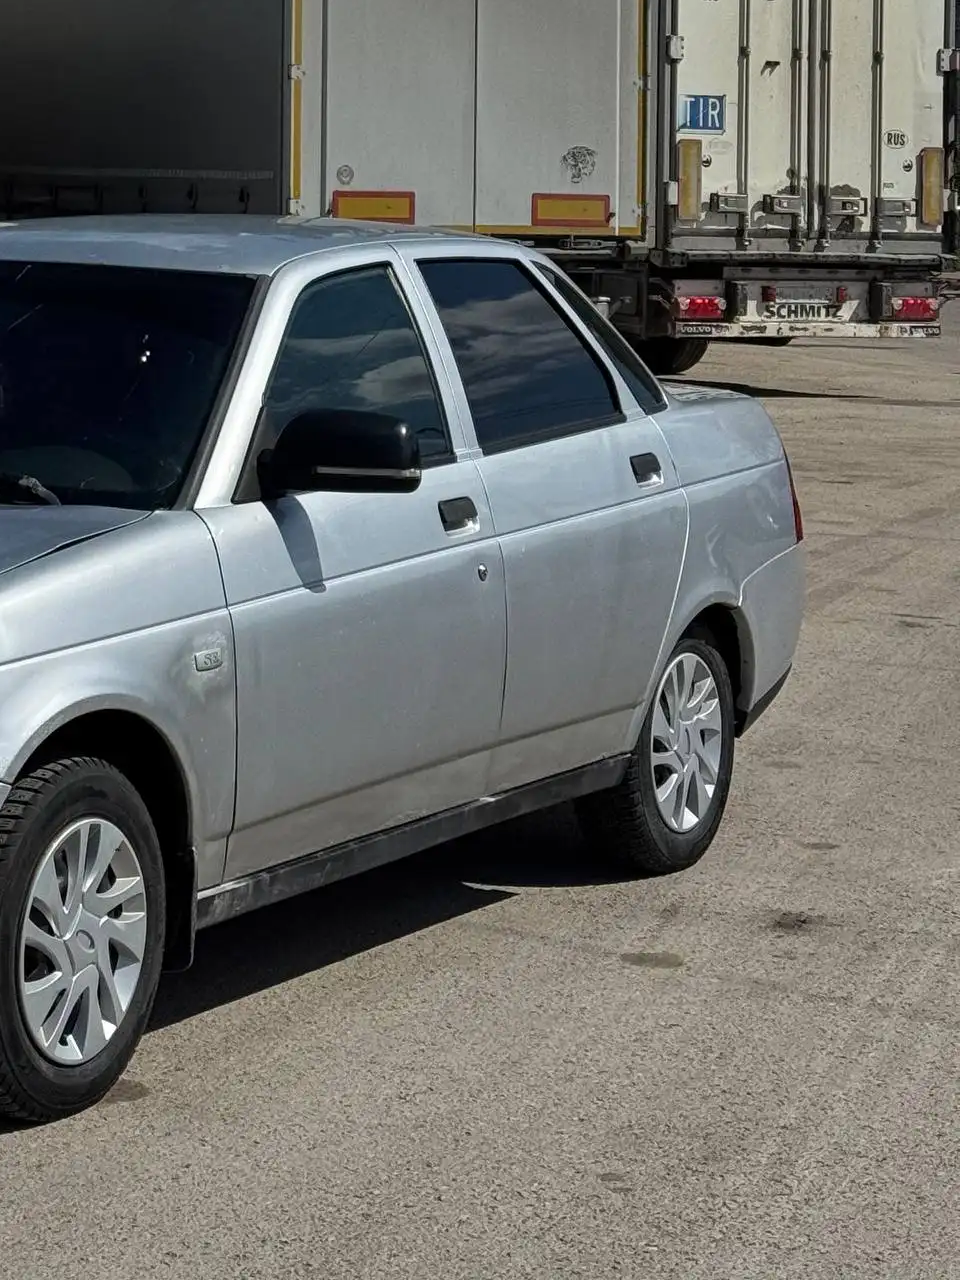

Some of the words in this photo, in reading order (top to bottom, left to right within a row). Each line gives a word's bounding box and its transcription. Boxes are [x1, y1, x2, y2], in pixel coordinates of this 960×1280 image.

[683, 97, 720, 128] TIR
[887, 132, 906, 146] RUS
[765, 303, 844, 319] SCHMITZ
[680, 325, 711, 333] VOLVO
